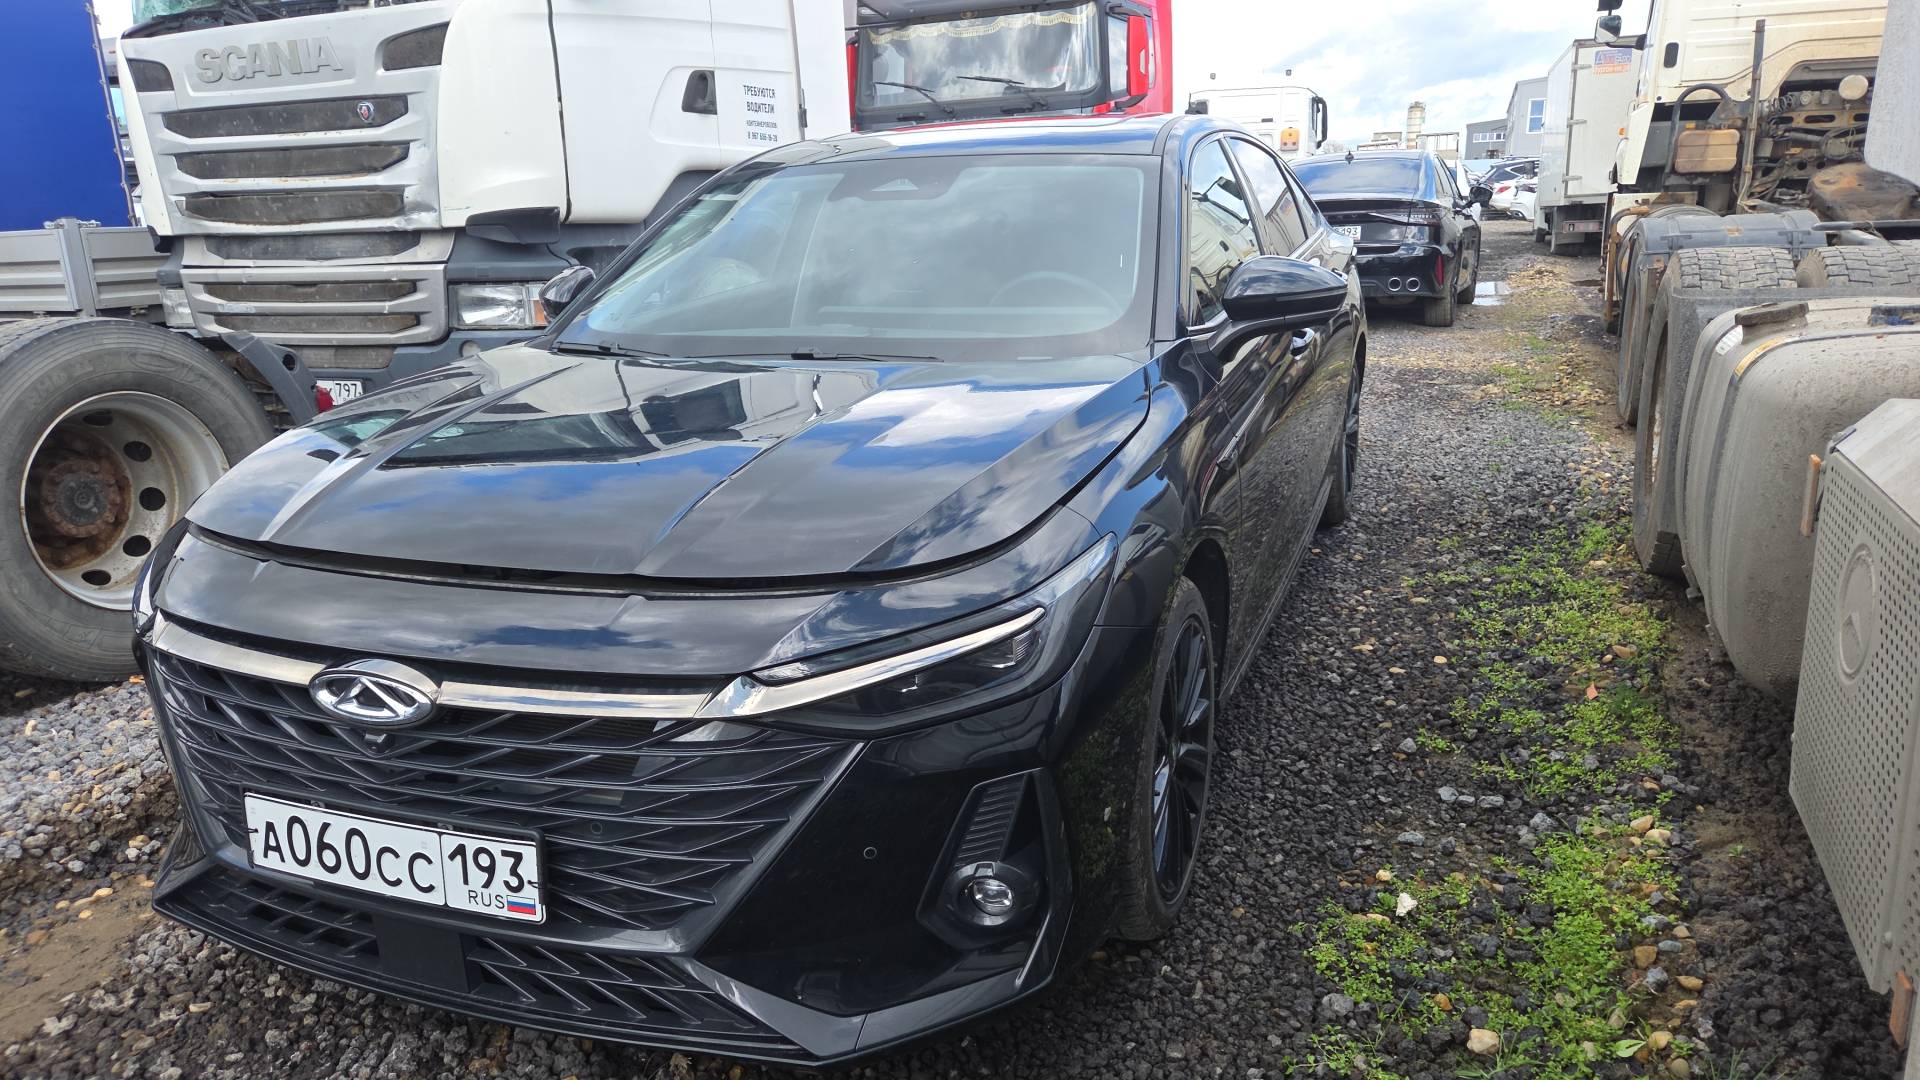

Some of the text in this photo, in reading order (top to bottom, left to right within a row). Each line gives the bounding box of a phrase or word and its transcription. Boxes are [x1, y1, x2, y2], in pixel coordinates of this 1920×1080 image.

[195, 36, 343, 84] SCANIA
[743, 85, 776, 99] ТРЕБУЮТСЯ
[746, 101, 775, 114] ВОДИТЕЛИ
[335, 382, 358, 398] 797
[447, 843, 526, 894] 193
[467, 889, 506, 910] RUS
